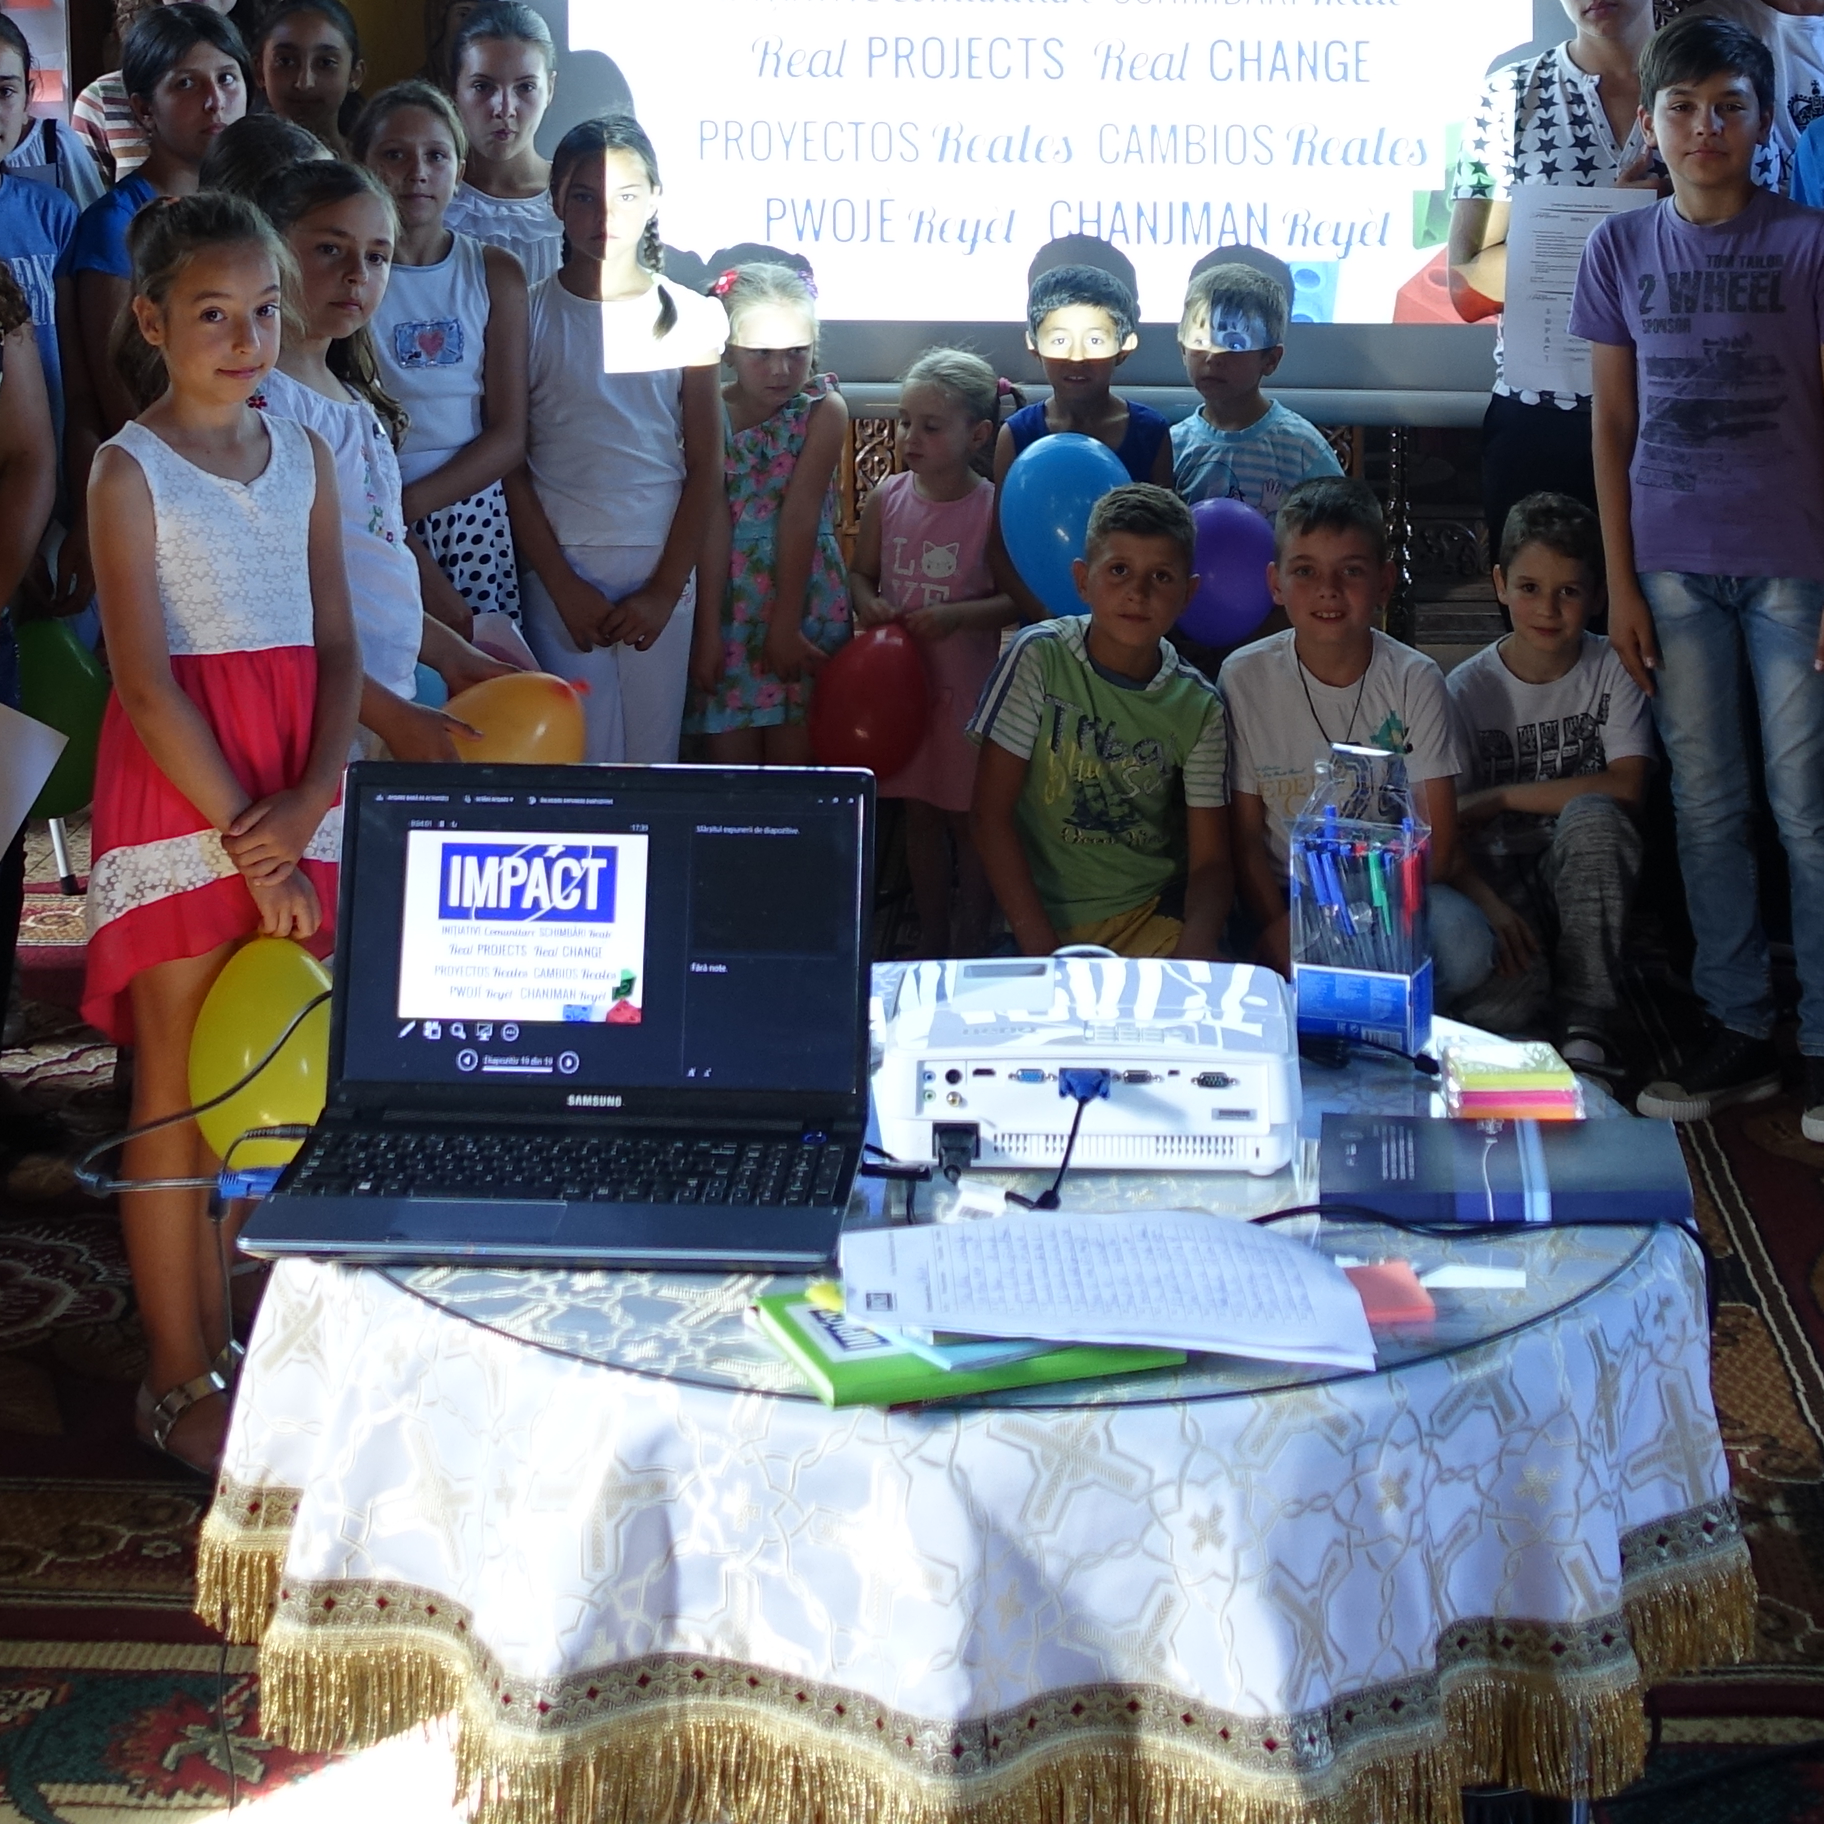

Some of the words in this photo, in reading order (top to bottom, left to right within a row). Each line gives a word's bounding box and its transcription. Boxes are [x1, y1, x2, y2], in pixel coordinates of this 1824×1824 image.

[751, 33, 848, 79] Real
[867, 35, 1065, 80] PROJECTS
[1092, 36, 1191, 82] Real
[1208, 38, 1371, 83] CHANGE
[698, 119, 920, 163] PROYECTOS
[931, 119, 1075, 164] Reales
[1098, 122, 1275, 166] CAMBIOS
[1285, 121, 1430, 167] Reales
[906, 204, 1016, 256] Reyèl
[1049, 199, 1269, 246] CHANJMAN
[1281, 206, 1392, 260] Reyèl
[1706, 254, 1735, 268] TOM
[1740, 254, 1784, 269] TAILOR
[1637, 273, 1656, 315] 2
[1667, 269, 1787, 314] WHEEL
[1641, 318, 1692, 334] SPONSOR
[448, 855, 608, 911] IMPACT
[477, 944, 528, 957] PROJECTS
[562, 946, 604, 959] CHANGE
[434, 964, 490, 977] PROYECTOS
[533, 967, 578, 979] CAMBIOS
[566, 1093, 622, 1108] SAMSUNG
